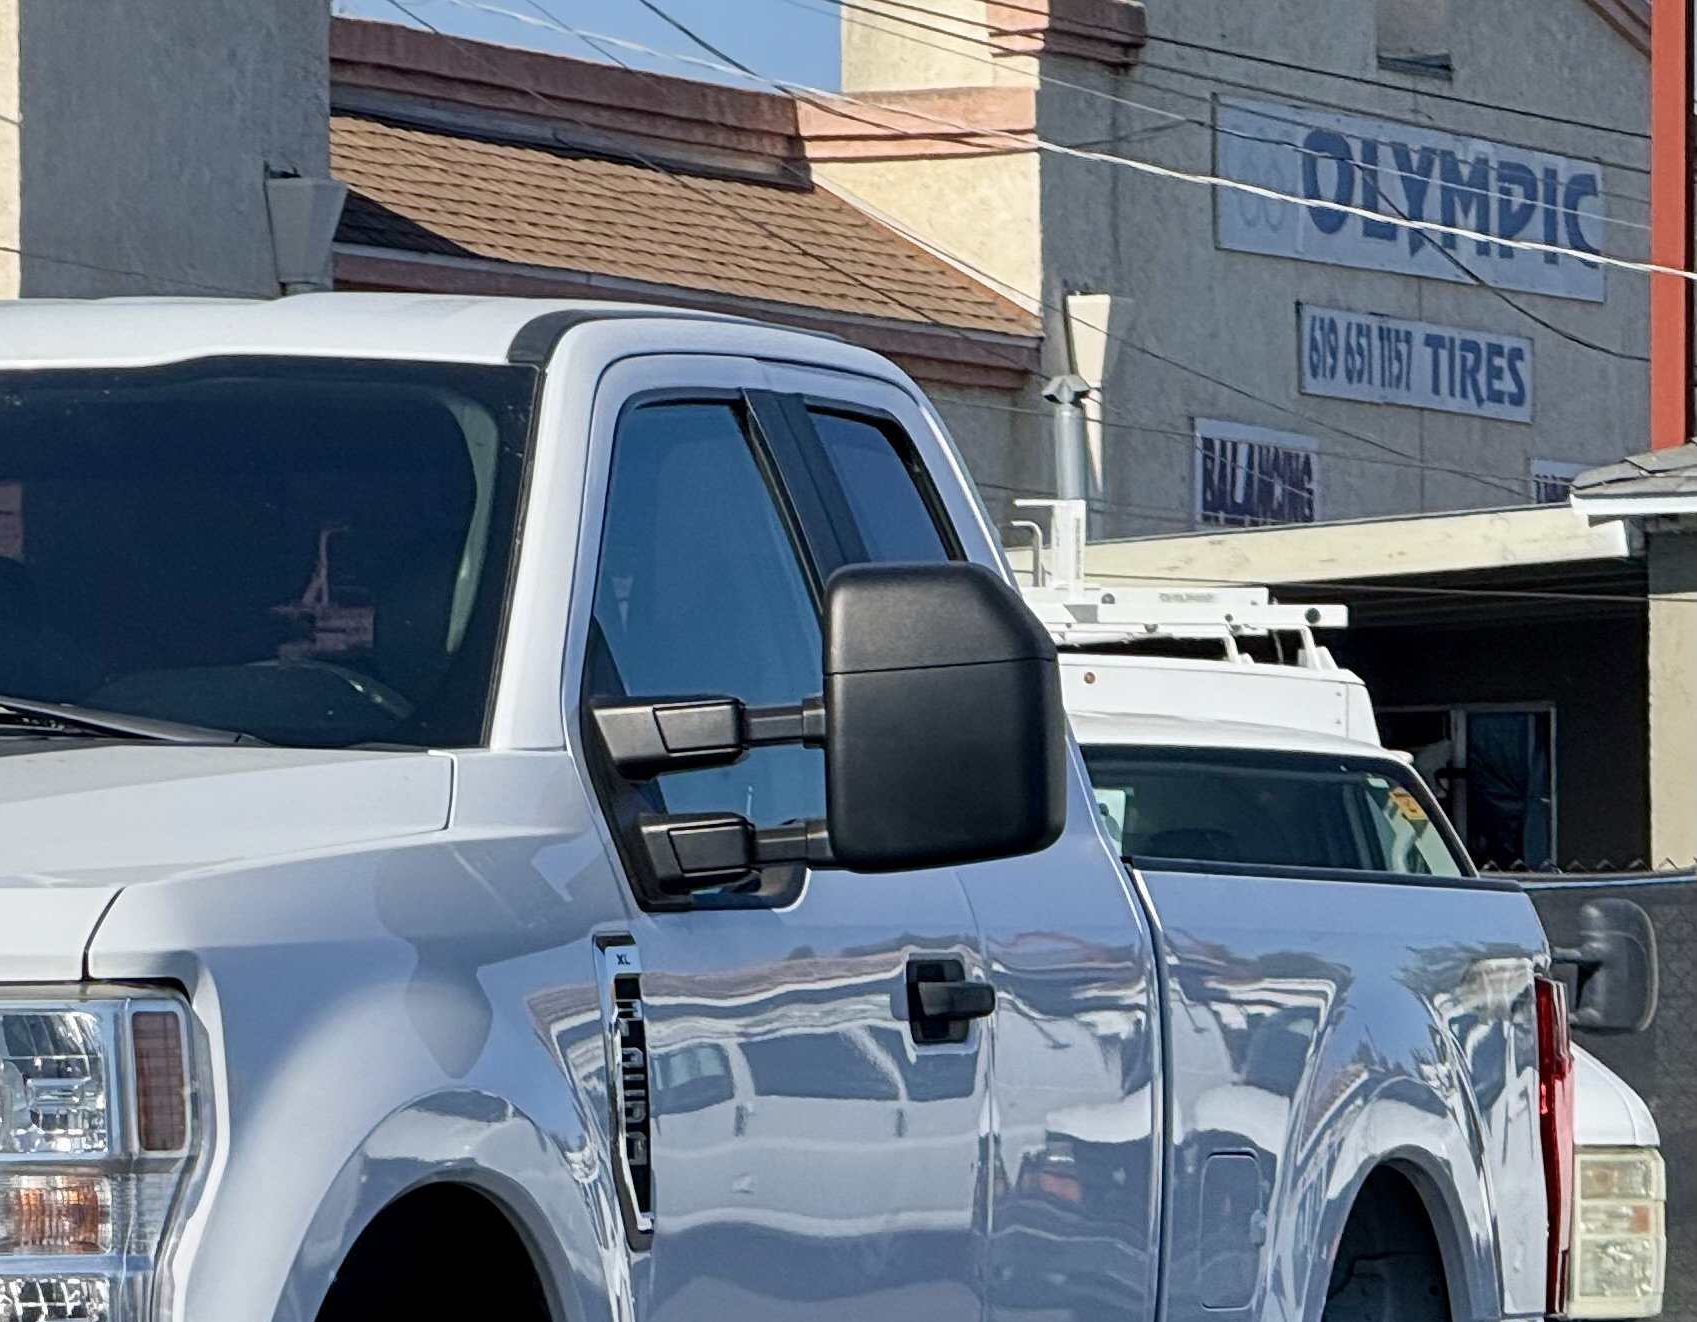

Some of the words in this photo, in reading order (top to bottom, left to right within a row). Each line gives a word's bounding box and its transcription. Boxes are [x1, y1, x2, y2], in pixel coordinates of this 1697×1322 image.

[1303, 128, 1599, 270] OLYMPIC
[1309, 314, 1339, 382] 619
[1423, 332, 1526, 409] TIRES
[616, 953, 630, 965] XL
